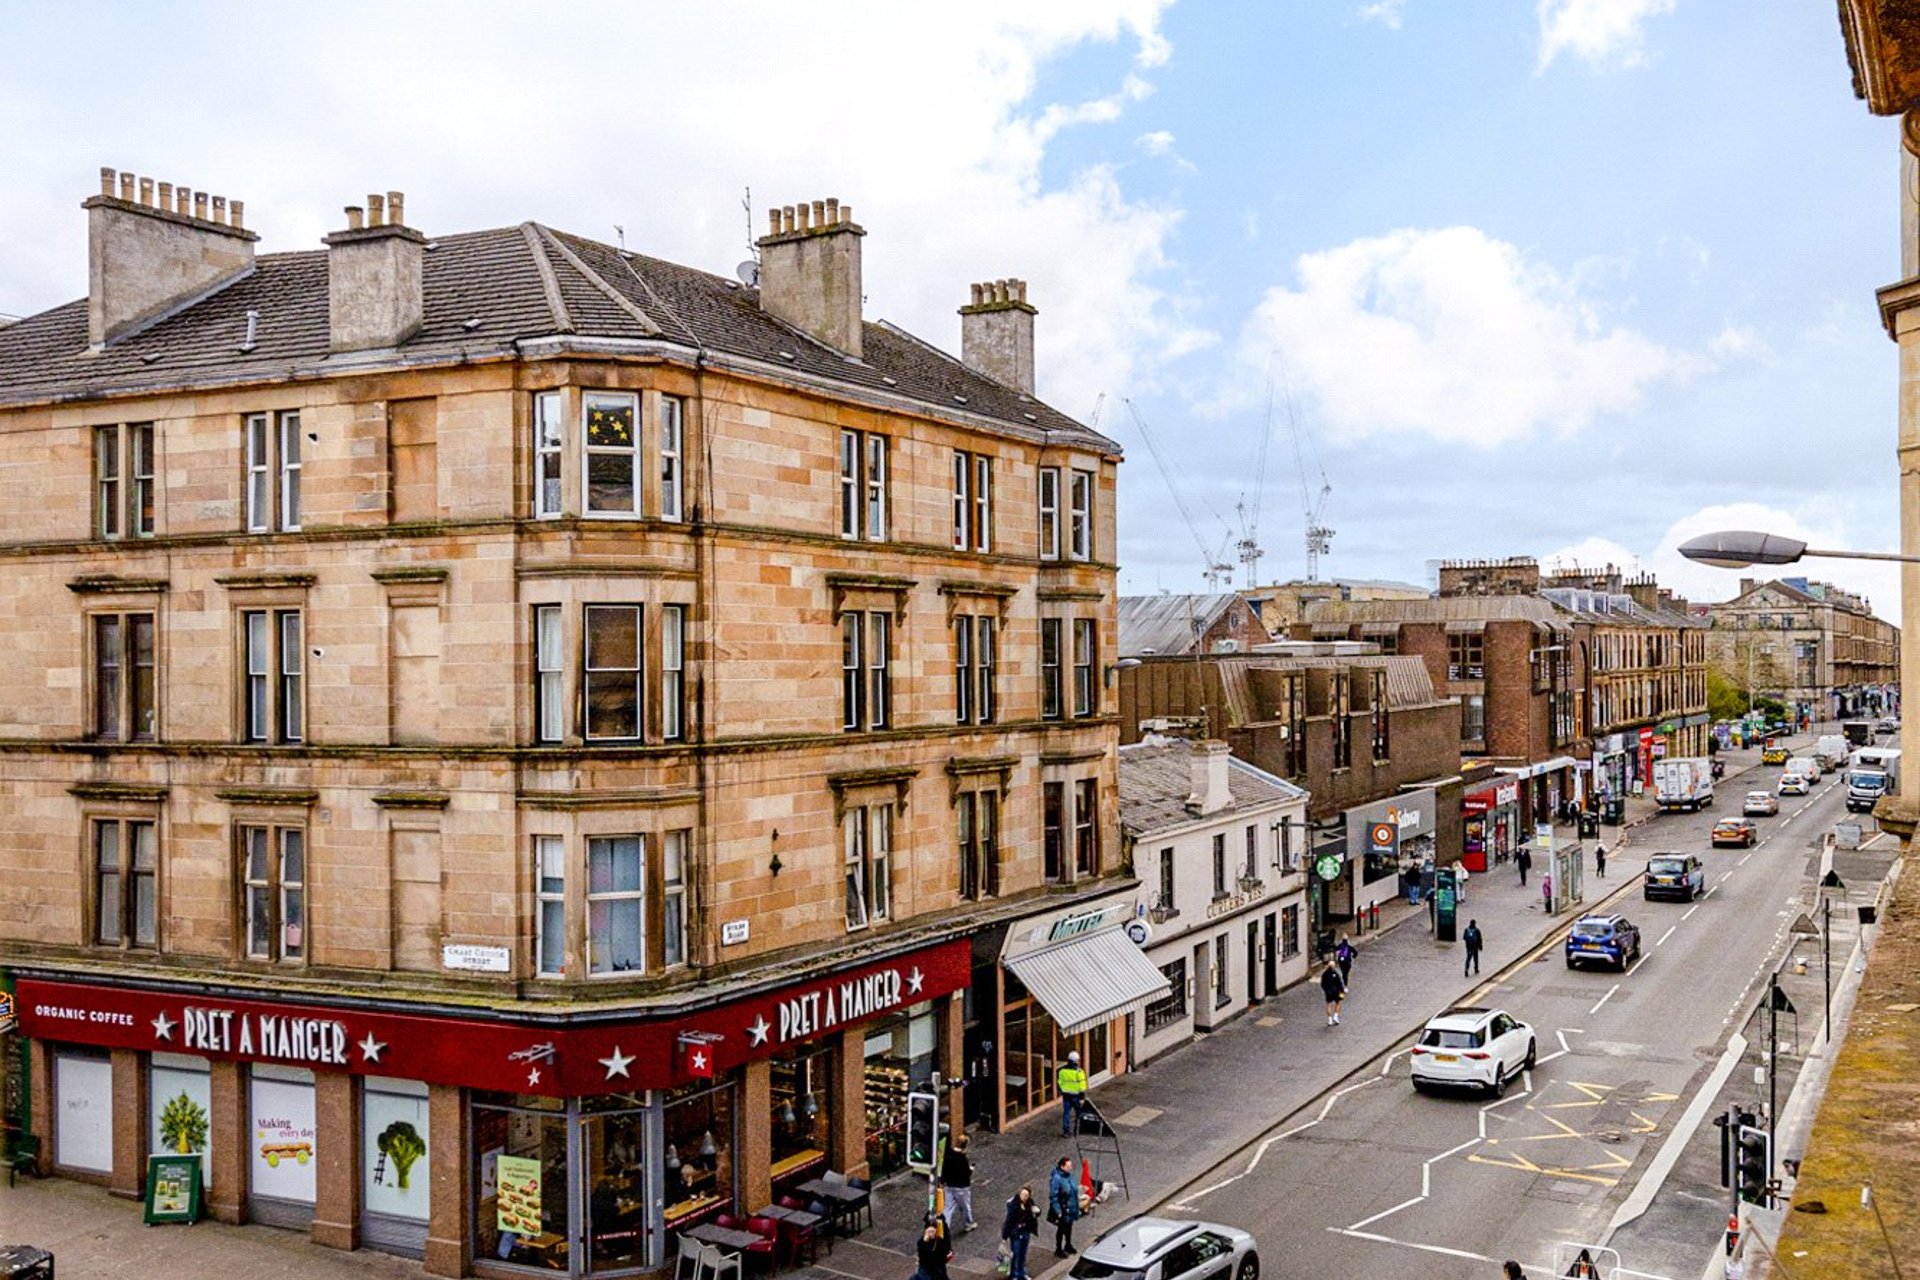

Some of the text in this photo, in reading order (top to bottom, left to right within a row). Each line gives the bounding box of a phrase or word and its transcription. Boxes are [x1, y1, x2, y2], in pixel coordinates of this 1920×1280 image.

[35, 1004, 134, 1026] ORGANIC COFFEE
[779, 968, 901, 1042] PRET A MANGER
[183, 1006, 348, 1065] PRET A MANGER
[257, 1117, 292, 1130] Making
[279, 1128, 315, 1140] every day
